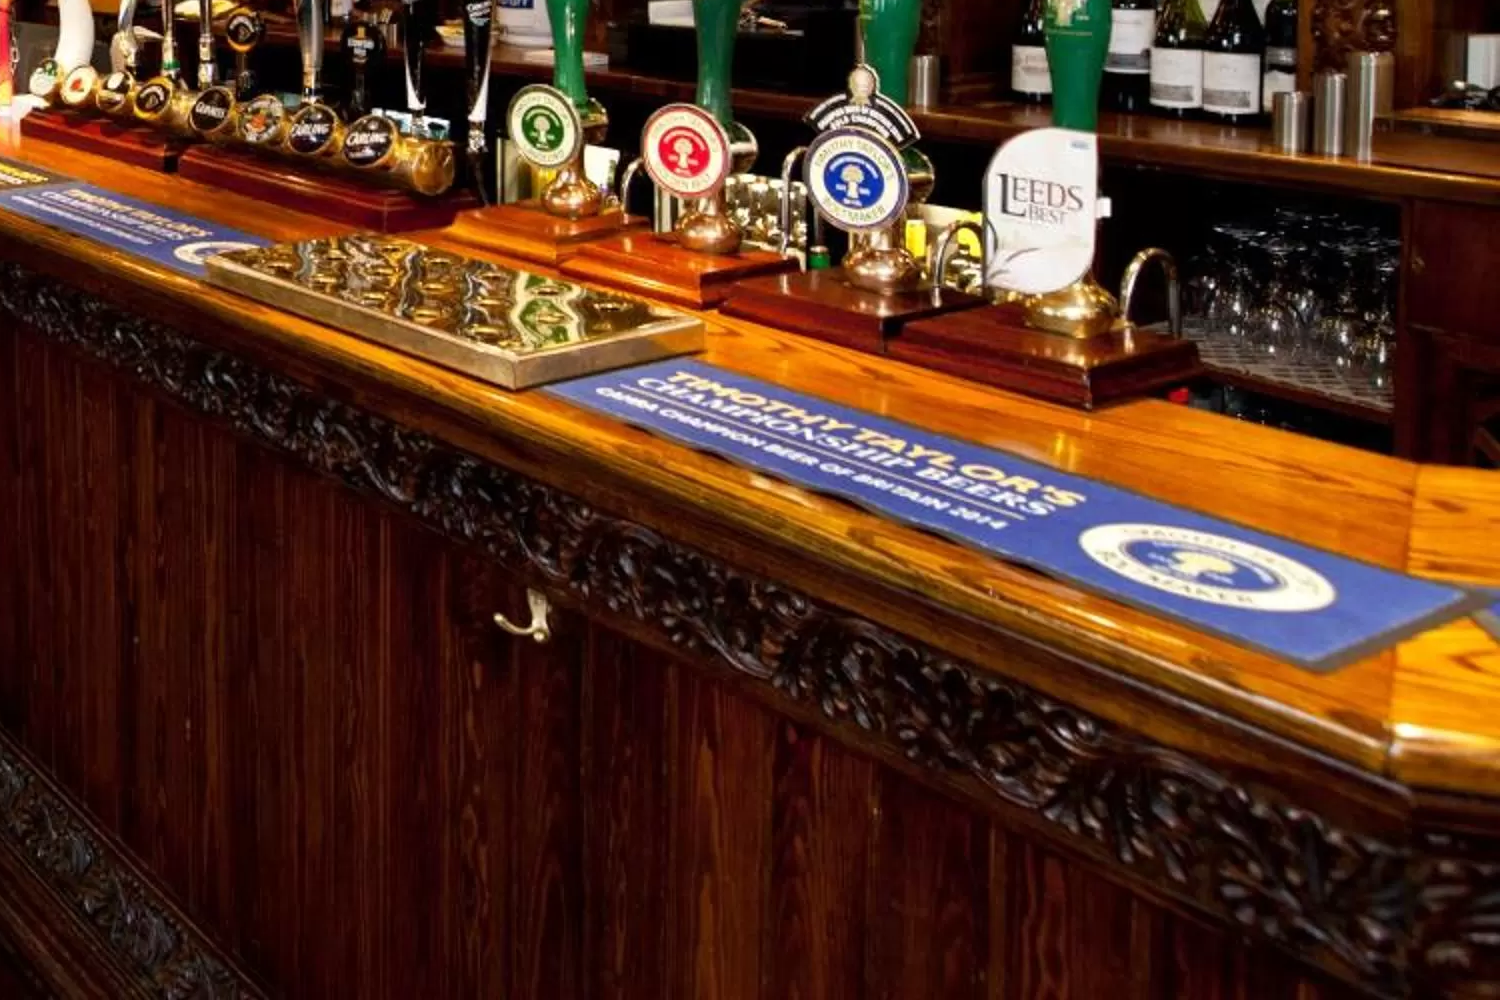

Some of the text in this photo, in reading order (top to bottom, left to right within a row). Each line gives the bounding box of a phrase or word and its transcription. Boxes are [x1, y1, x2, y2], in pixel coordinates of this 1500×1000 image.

[996, 172, 1084, 218] LEEDS
[1028, 203, 1068, 226] BEST
[636, 376, 1058, 517] CHAMPIONSHIP BEERS
[659, 408, 768, 448] CHAMPION
[762, 443, 820, 467] BEER
[819, 462, 855, 477] OF
[851, 473, 951, 512] BRITAIN
[948, 506, 1010, 531] 2014
[666, 370, 1088, 508] TIMOTHY TAYLOR'S
